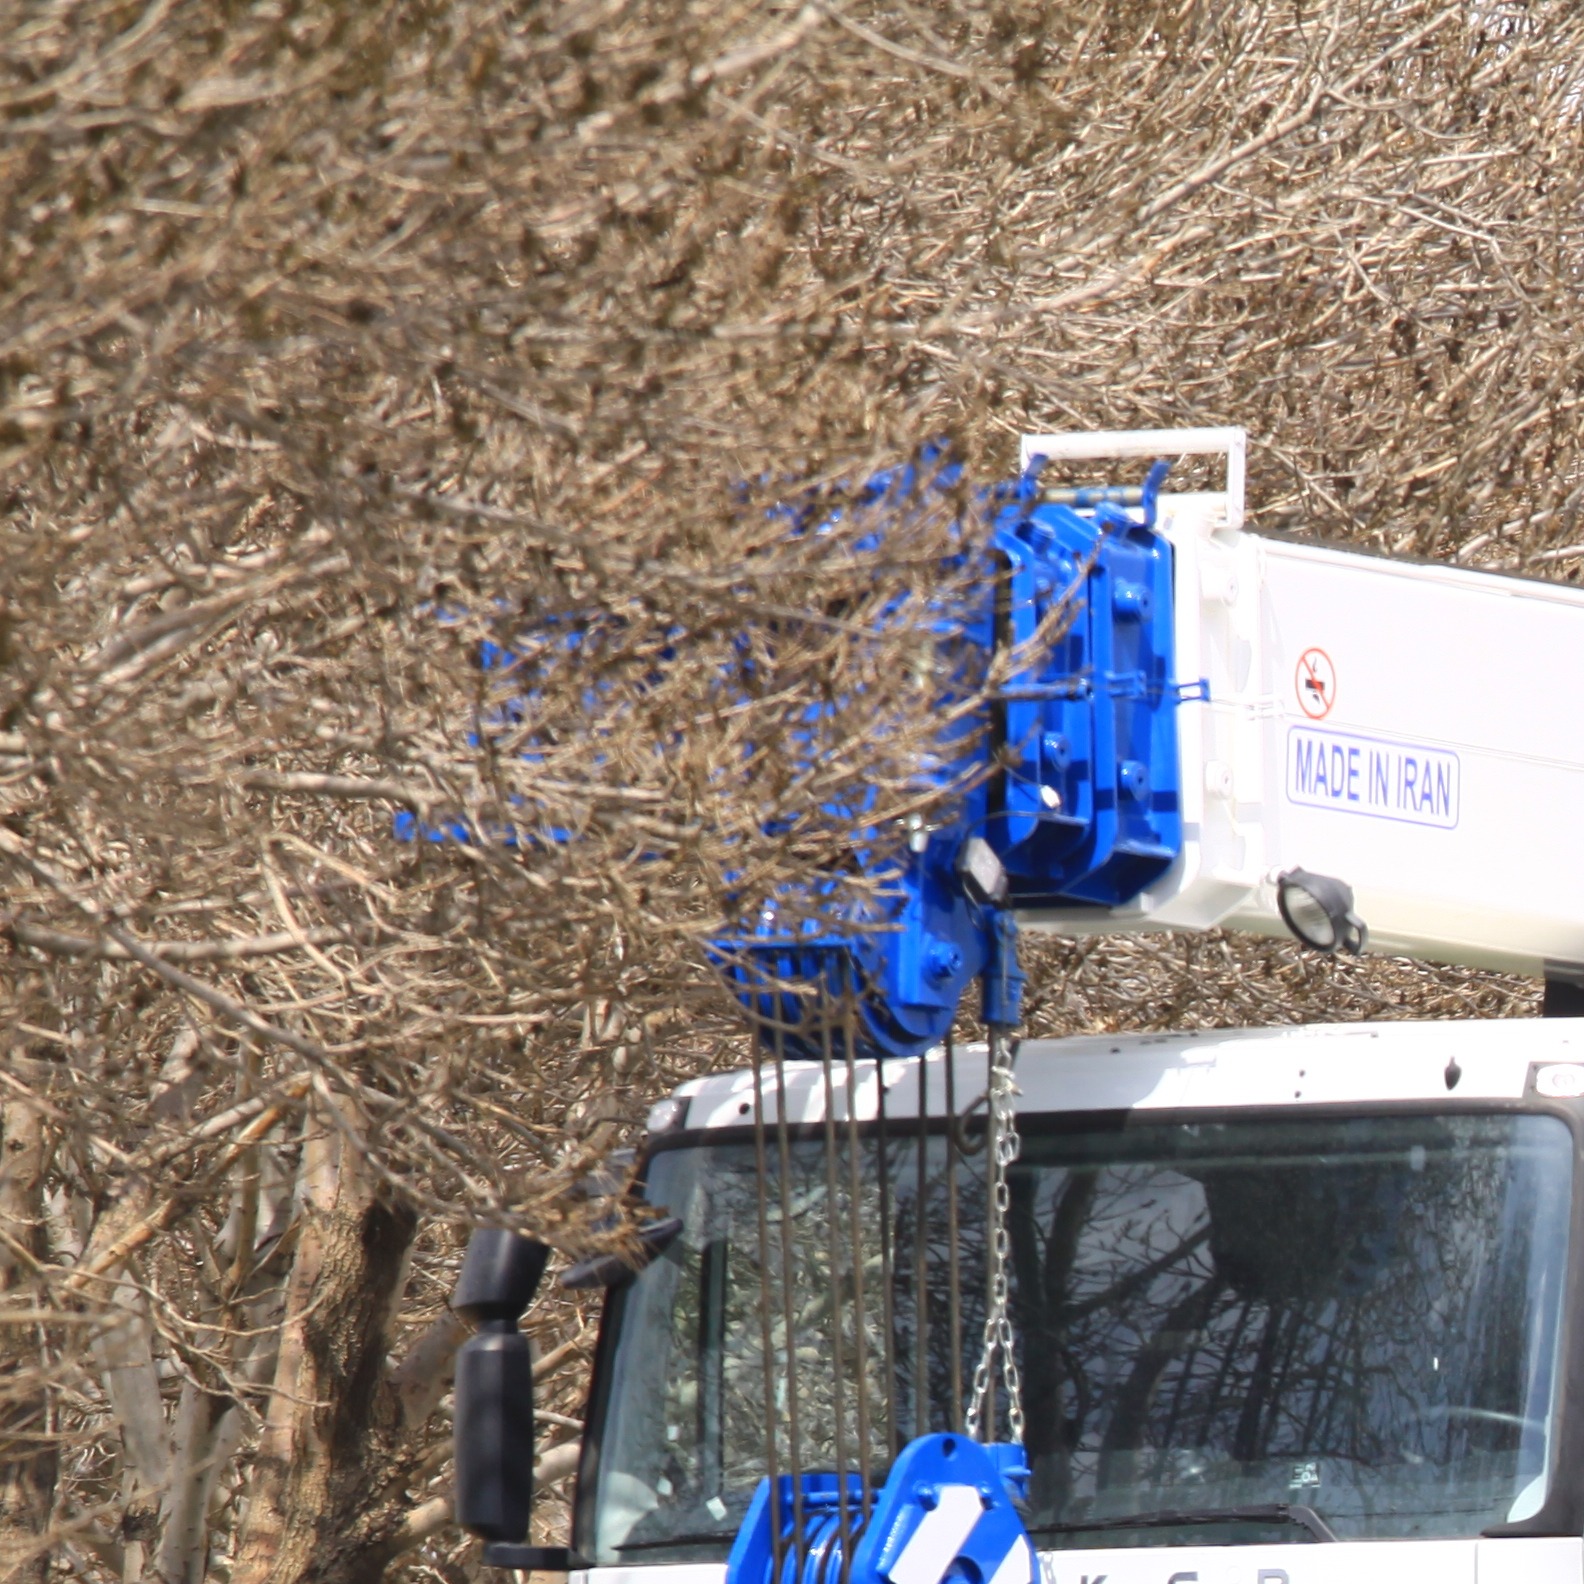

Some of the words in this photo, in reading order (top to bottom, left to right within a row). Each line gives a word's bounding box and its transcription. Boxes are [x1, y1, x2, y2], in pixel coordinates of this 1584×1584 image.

[1295, 739, 1360, 800] MADE
[1368, 748, 1390, 807] IN
[1397, 754, 1451, 817] IRAN
